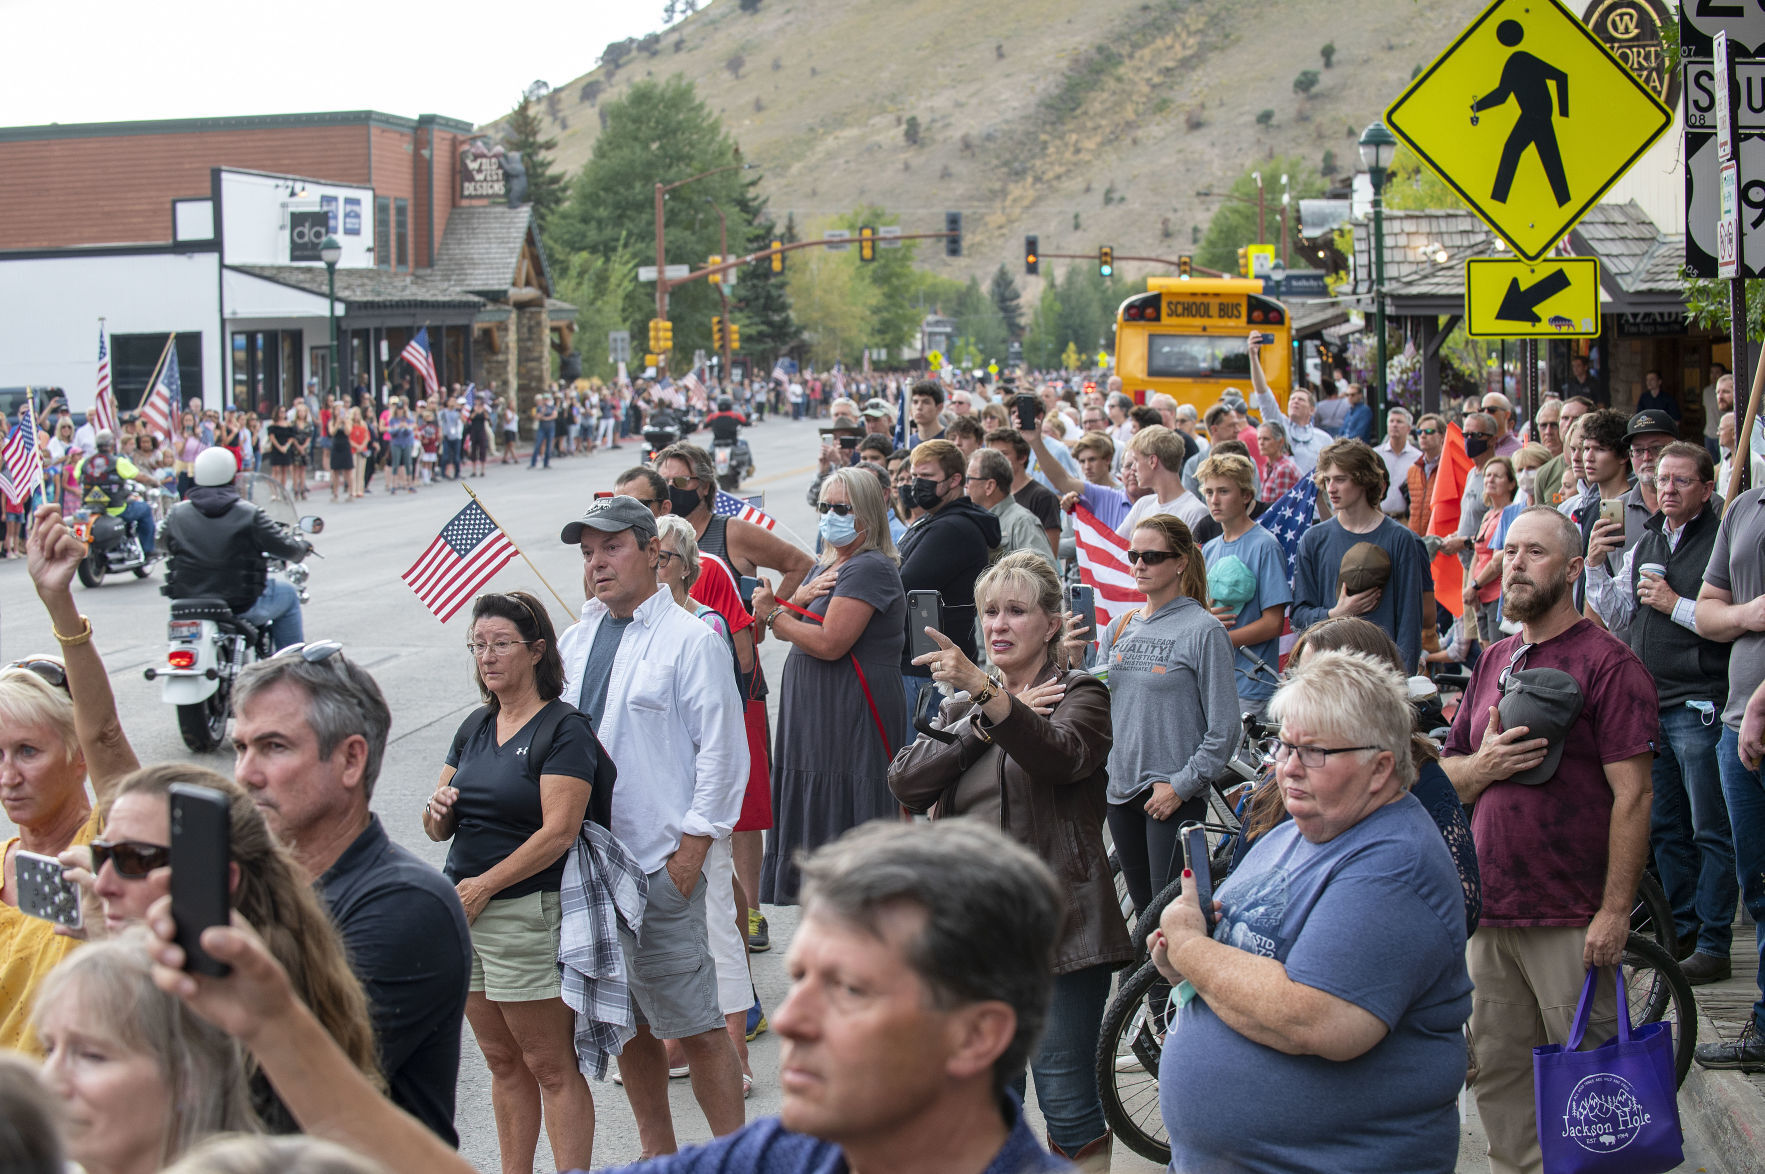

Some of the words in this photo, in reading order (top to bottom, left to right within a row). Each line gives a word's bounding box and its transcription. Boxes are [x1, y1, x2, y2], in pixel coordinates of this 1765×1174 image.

[1681, 45, 1696, 56] 07
[1693, 70, 1765, 114] SU
[1689, 114, 1706, 126] 08
[465, 157, 499, 170] WILD
[472, 169, 503, 181] WEST
[463, 181, 505, 196] DESIGNS
[1685, 264, 1699, 278] 05
[1166, 301, 1213, 319] SCHOOL
[1218, 302, 1242, 319] BUS
[1109, 643, 1168, 655] UALITY
[1562, 1113, 1613, 1137] Jackson
[1618, 1105, 1652, 1130] Hole
